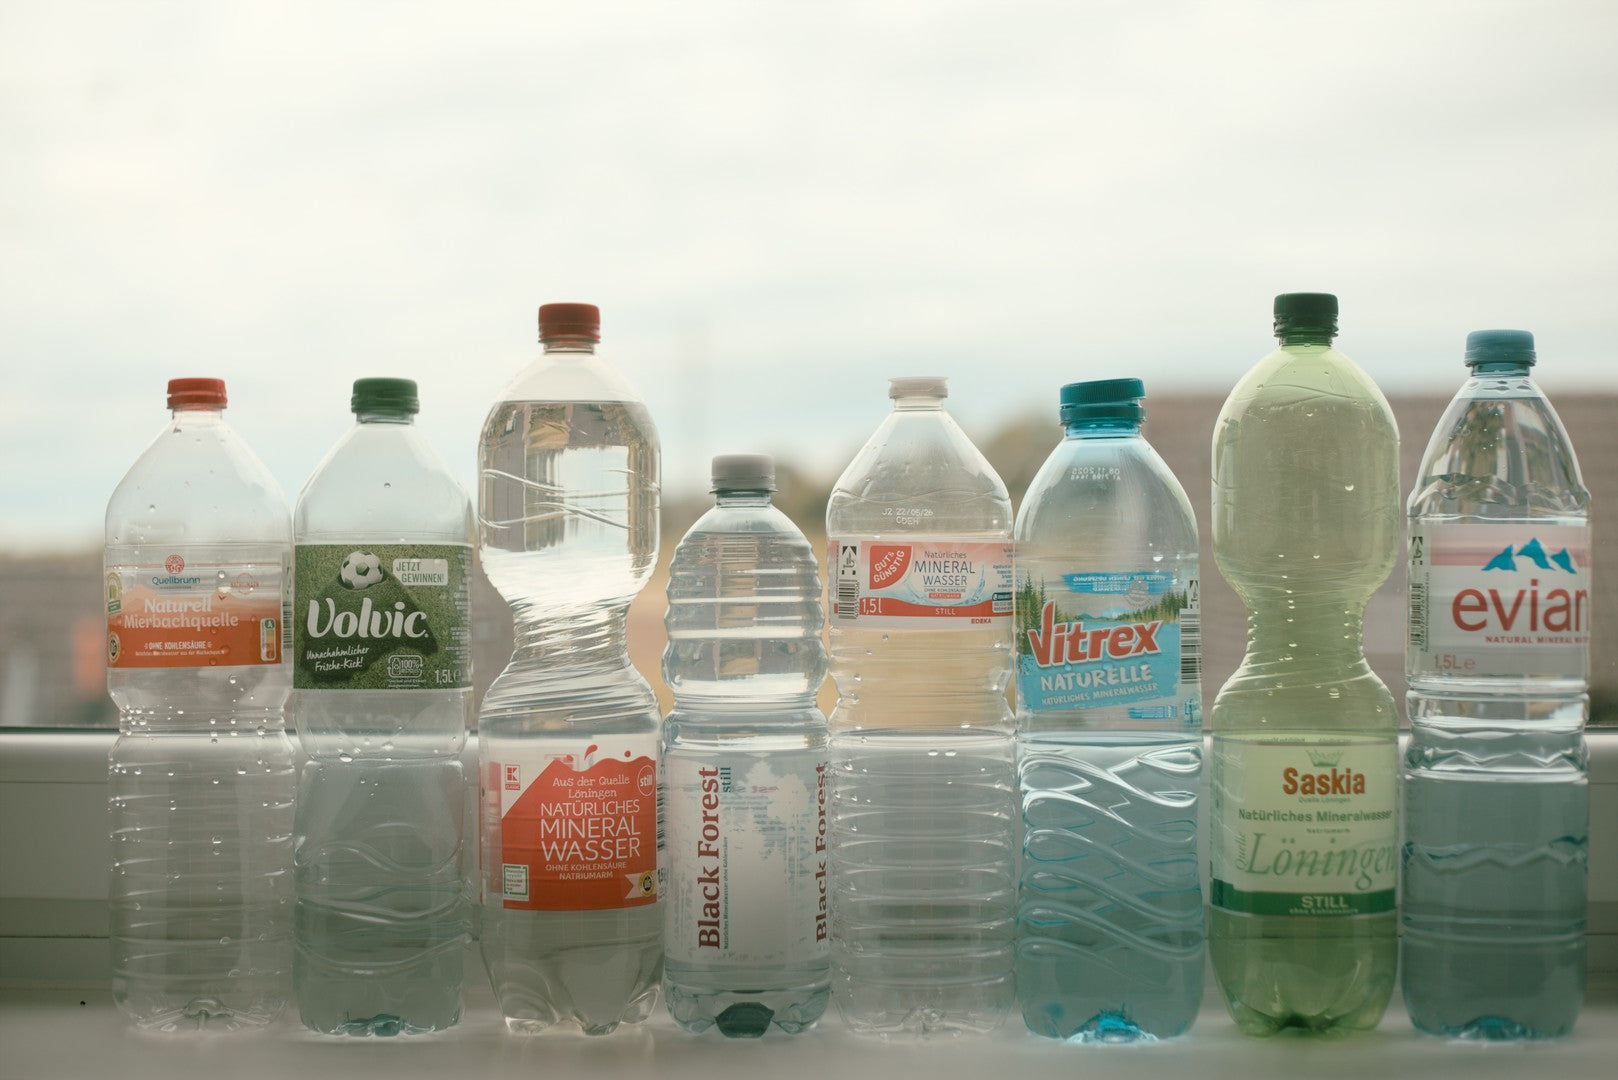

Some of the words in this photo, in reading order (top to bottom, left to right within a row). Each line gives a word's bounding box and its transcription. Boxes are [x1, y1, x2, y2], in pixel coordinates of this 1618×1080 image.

[924, 551, 967, 559] Natürliches
[396, 562, 421, 572] JETZT
[873, 551, 905, 583] GÜNSTIG
[914, 560, 976, 574] MINERAL
[152, 576, 200, 586] Quellbrunn
[401, 573, 444, 583] GEWINNEN!
[923, 575, 967, 586] WASSER
[144, 598, 212, 613] Naturell
[935, 608, 956, 616] STILL
[124, 613, 239, 631] Mierbachquelle
[307, 597, 428, 638] Volvic
[1027, 600, 1163, 668] Vitrex
[1485, 636, 1533, 644] NATURAL
[1537, 636, 1572, 644] MINERAL
[149, 642, 163, 650] OHNE
[164, 640, 207, 650] KOHLENSÄURE
[306, 644, 370, 660] Unnachahmlicher
[315, 657, 364, 672] Frische-Kick!
[401, 659, 420, 669] 100%
[434, 669, 453, 685] 1,5L
[1040, 664, 1153, 691] NATURELLE
[1041, 692, 1089, 705] NATÜRLICHES
[1093, 682, 1158, 699] MINERALWASSER
[552, 777, 574, 787] Aus
[577, 777, 596, 787] der
[599, 774, 630, 786] Quelle
[639, 774, 653, 787] still
[720, 767, 732, 793] still
[1282, 767, 1366, 795] Saskia
[568, 788, 617, 800] Löningen
[541, 800, 640, 817] NATÜRLICHES
[697, 766, 720, 859] Forest
[815, 763, 827, 854] Forest
[1239, 808, 1312, 822] Natürliches
[1317, 810, 1393, 822] Mineralwasser
[541, 816, 641, 839] MINERAL
[541, 837, 641, 862] WASSER
[545, 864, 569, 872] OHNE
[570, 861, 627, 871] KOHLENSÄURE
[559, 871, 614, 880] NATRIUMARM
[697, 866, 720, 949] Black
[815, 861, 827, 943] Black
[1301, 896, 1349, 908] STILL
